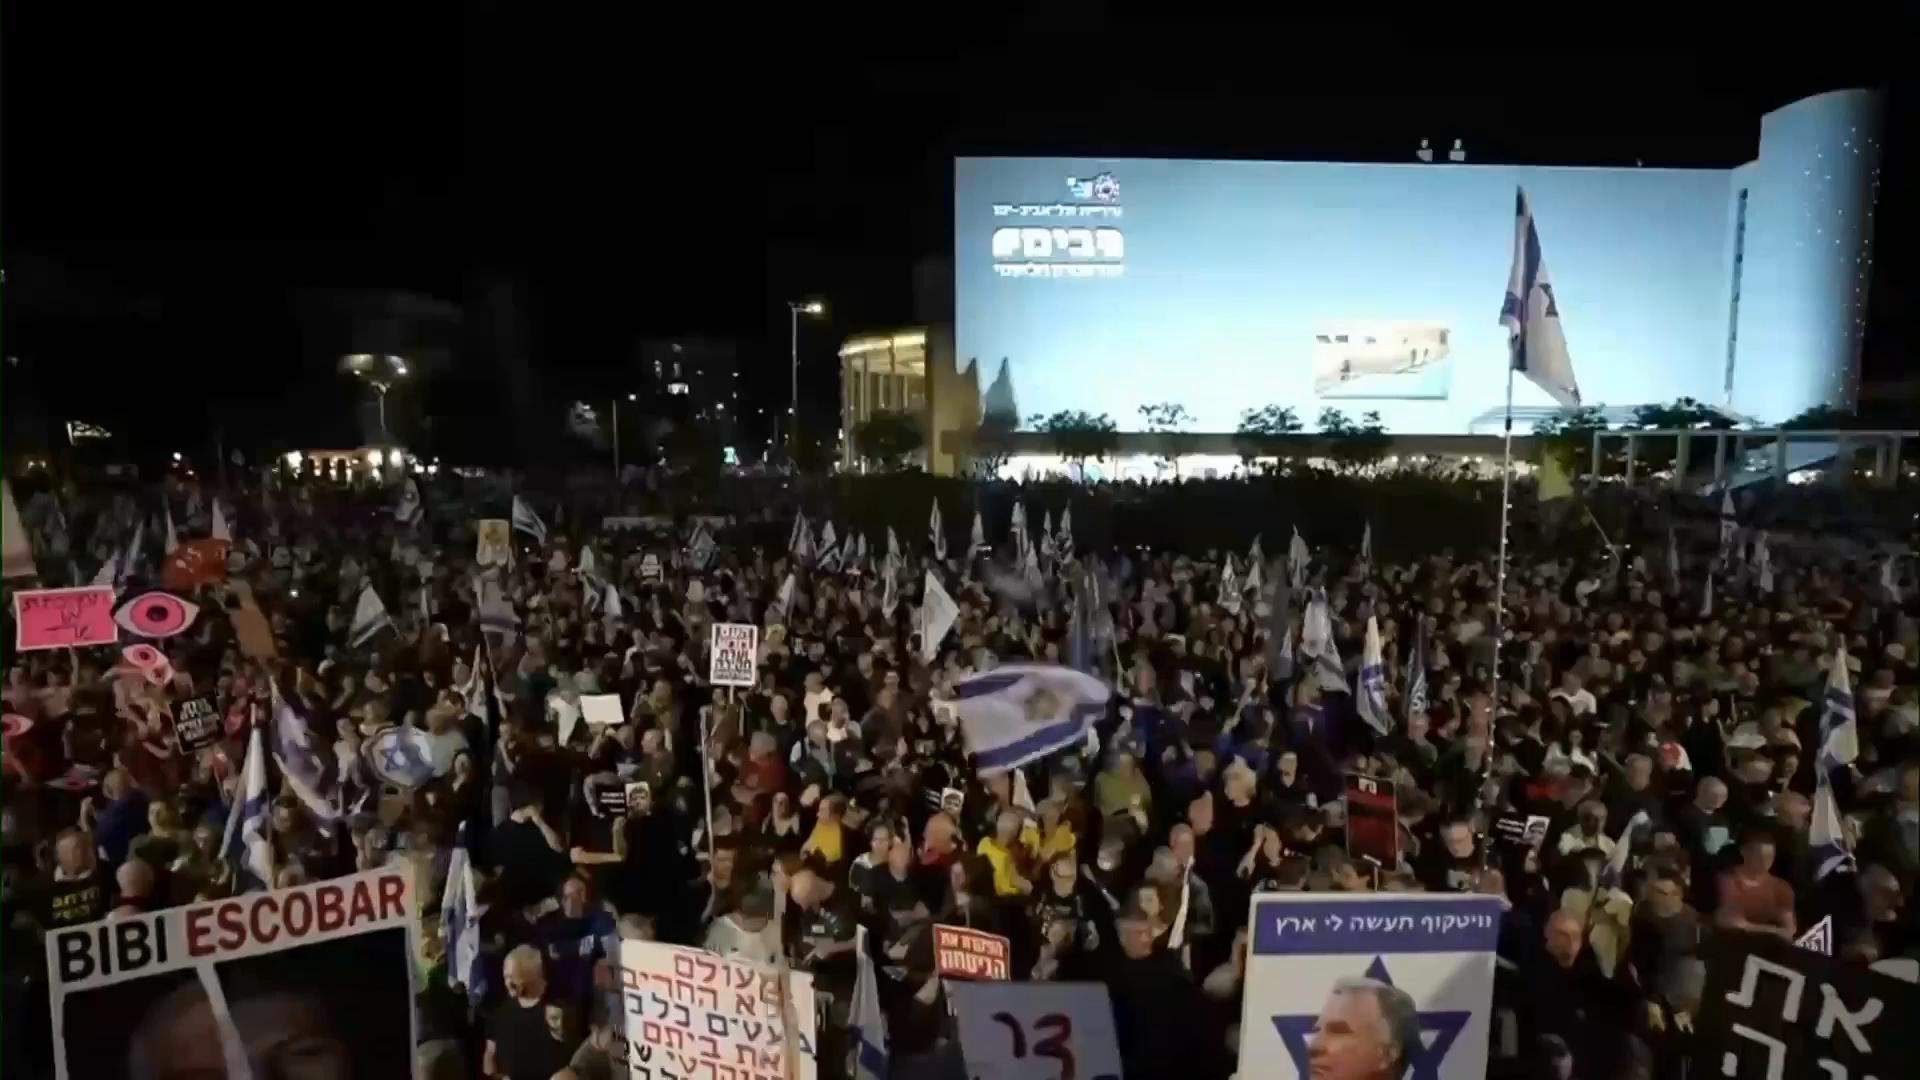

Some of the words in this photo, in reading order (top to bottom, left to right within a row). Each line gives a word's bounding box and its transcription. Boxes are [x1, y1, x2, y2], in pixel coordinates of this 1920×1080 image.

[57, 916, 168, 984] BIBI
[185, 875, 406, 958] ESCOBAR
[1276, 916, 1316, 936] ארץ
[1324, 914, 1343, 930] לי
[1351, 915, 1414, 931] תעשה
[1421, 914, 1492, 934] וויטקוף
[1724, 953, 1885, 1054] את
[642, 1020, 721, 1059] ביתם
[736, 1043, 782, 1072] את
